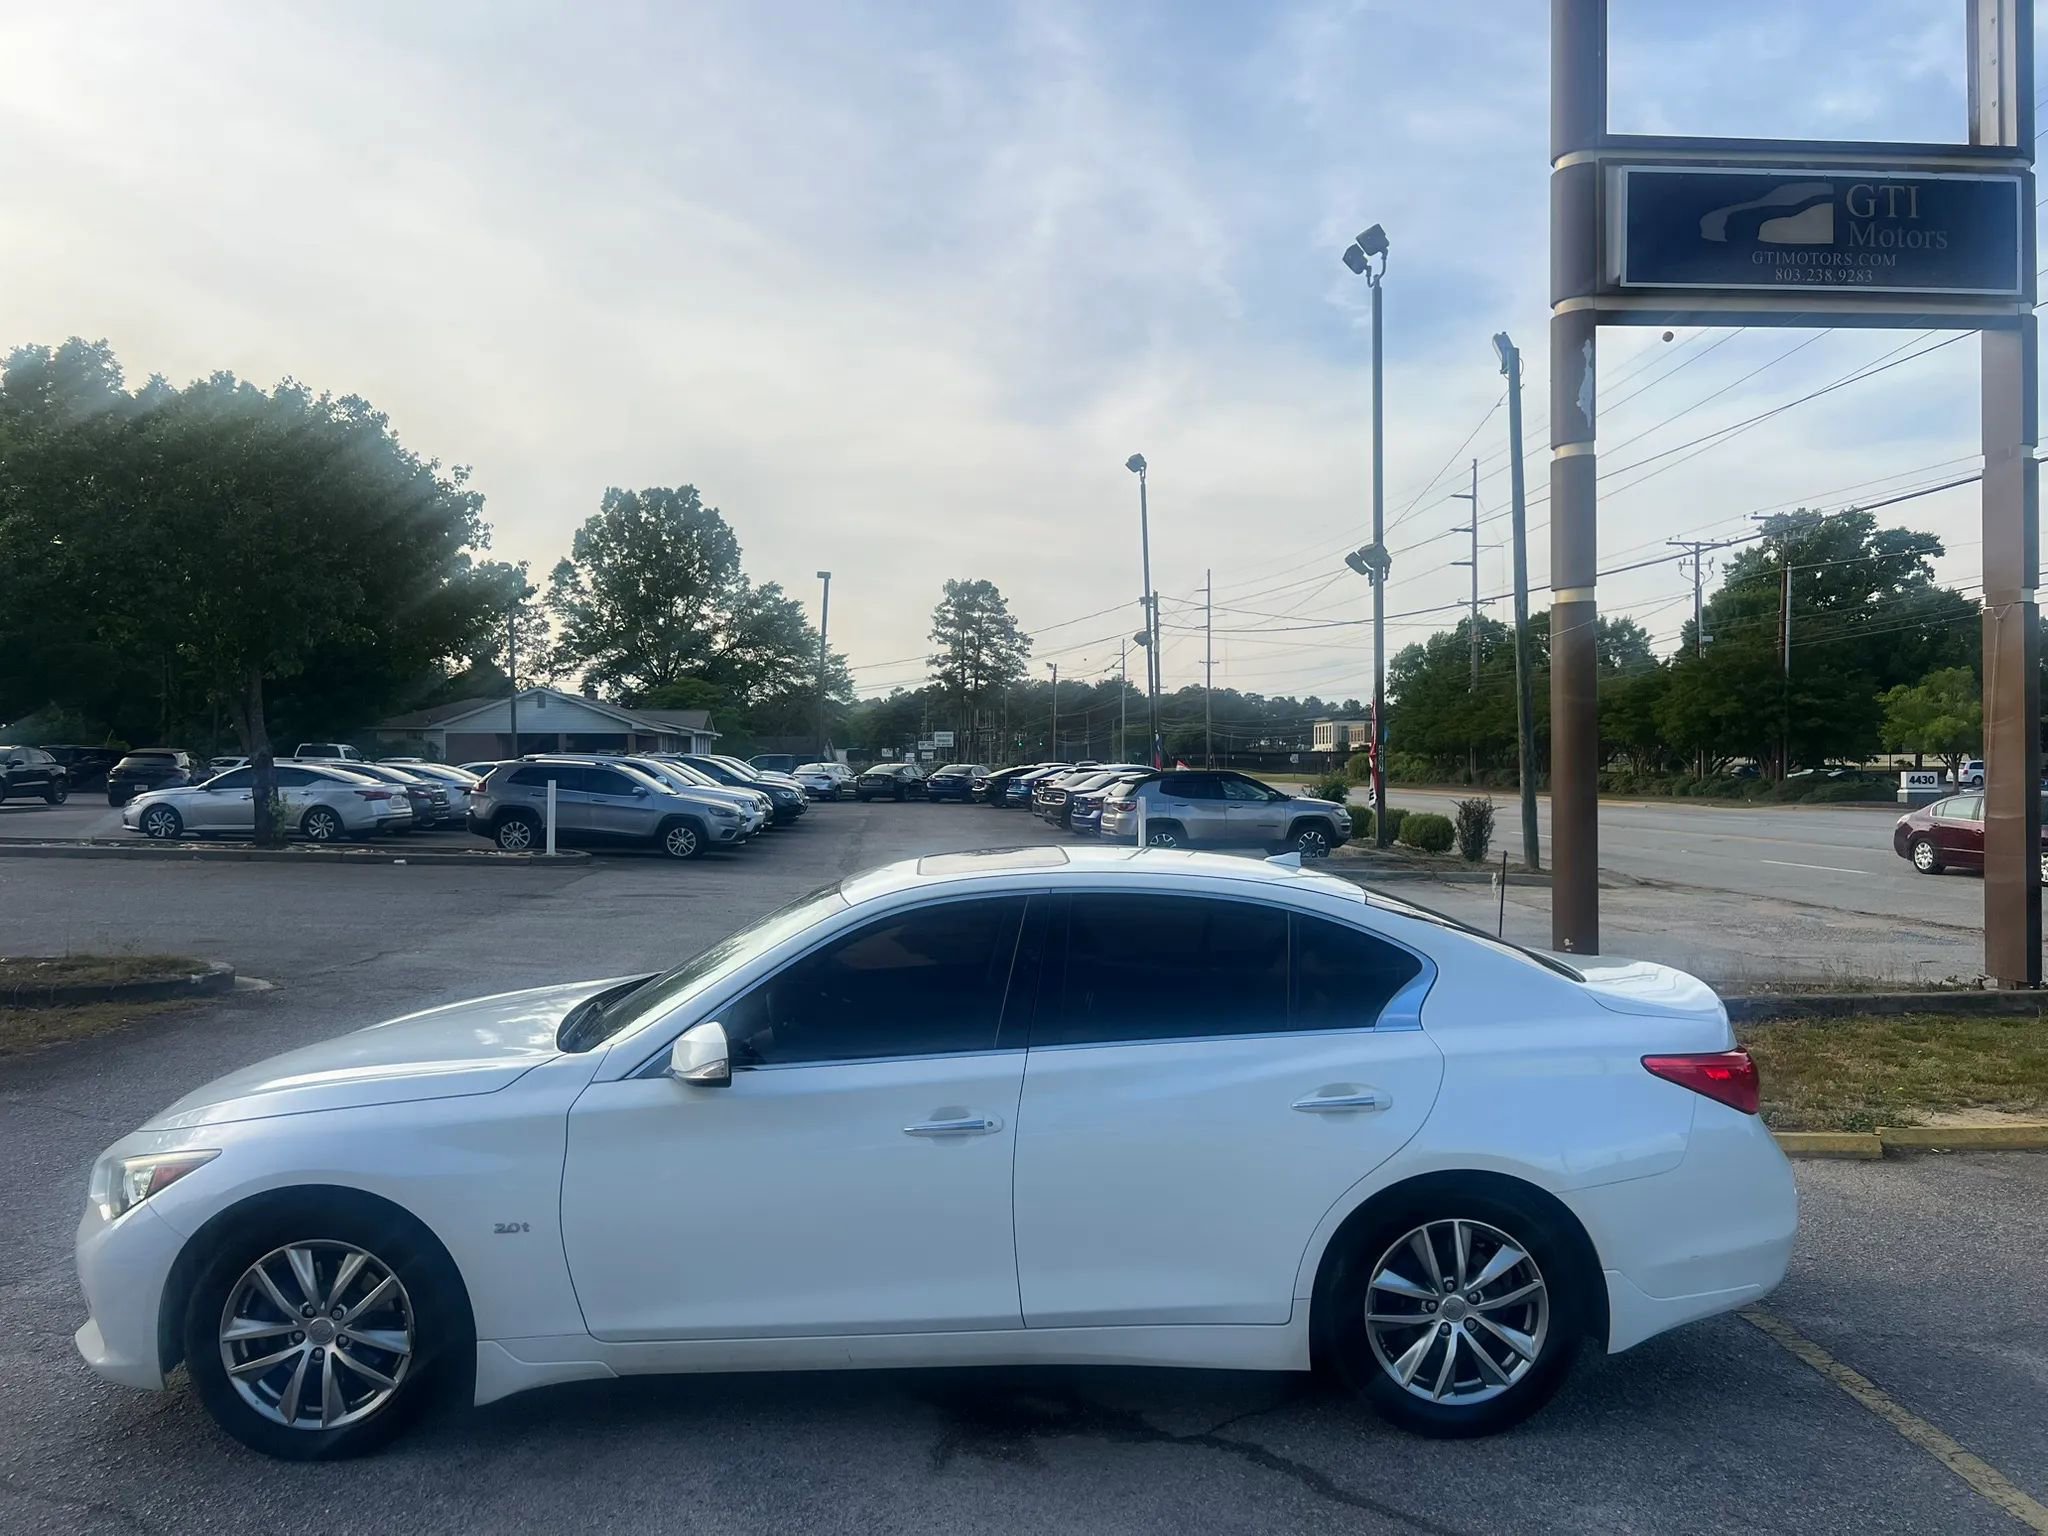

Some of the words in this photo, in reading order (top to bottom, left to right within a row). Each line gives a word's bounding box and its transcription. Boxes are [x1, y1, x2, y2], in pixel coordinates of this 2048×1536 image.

[1846, 183, 1921, 218] GTI
[1848, 221, 1948, 249] Motors
[1752, 251, 1897, 267] GTIMOTORS.COM
[1775, 268, 1873, 282] 803.238.9283
[1909, 775, 1935, 784] 4430
